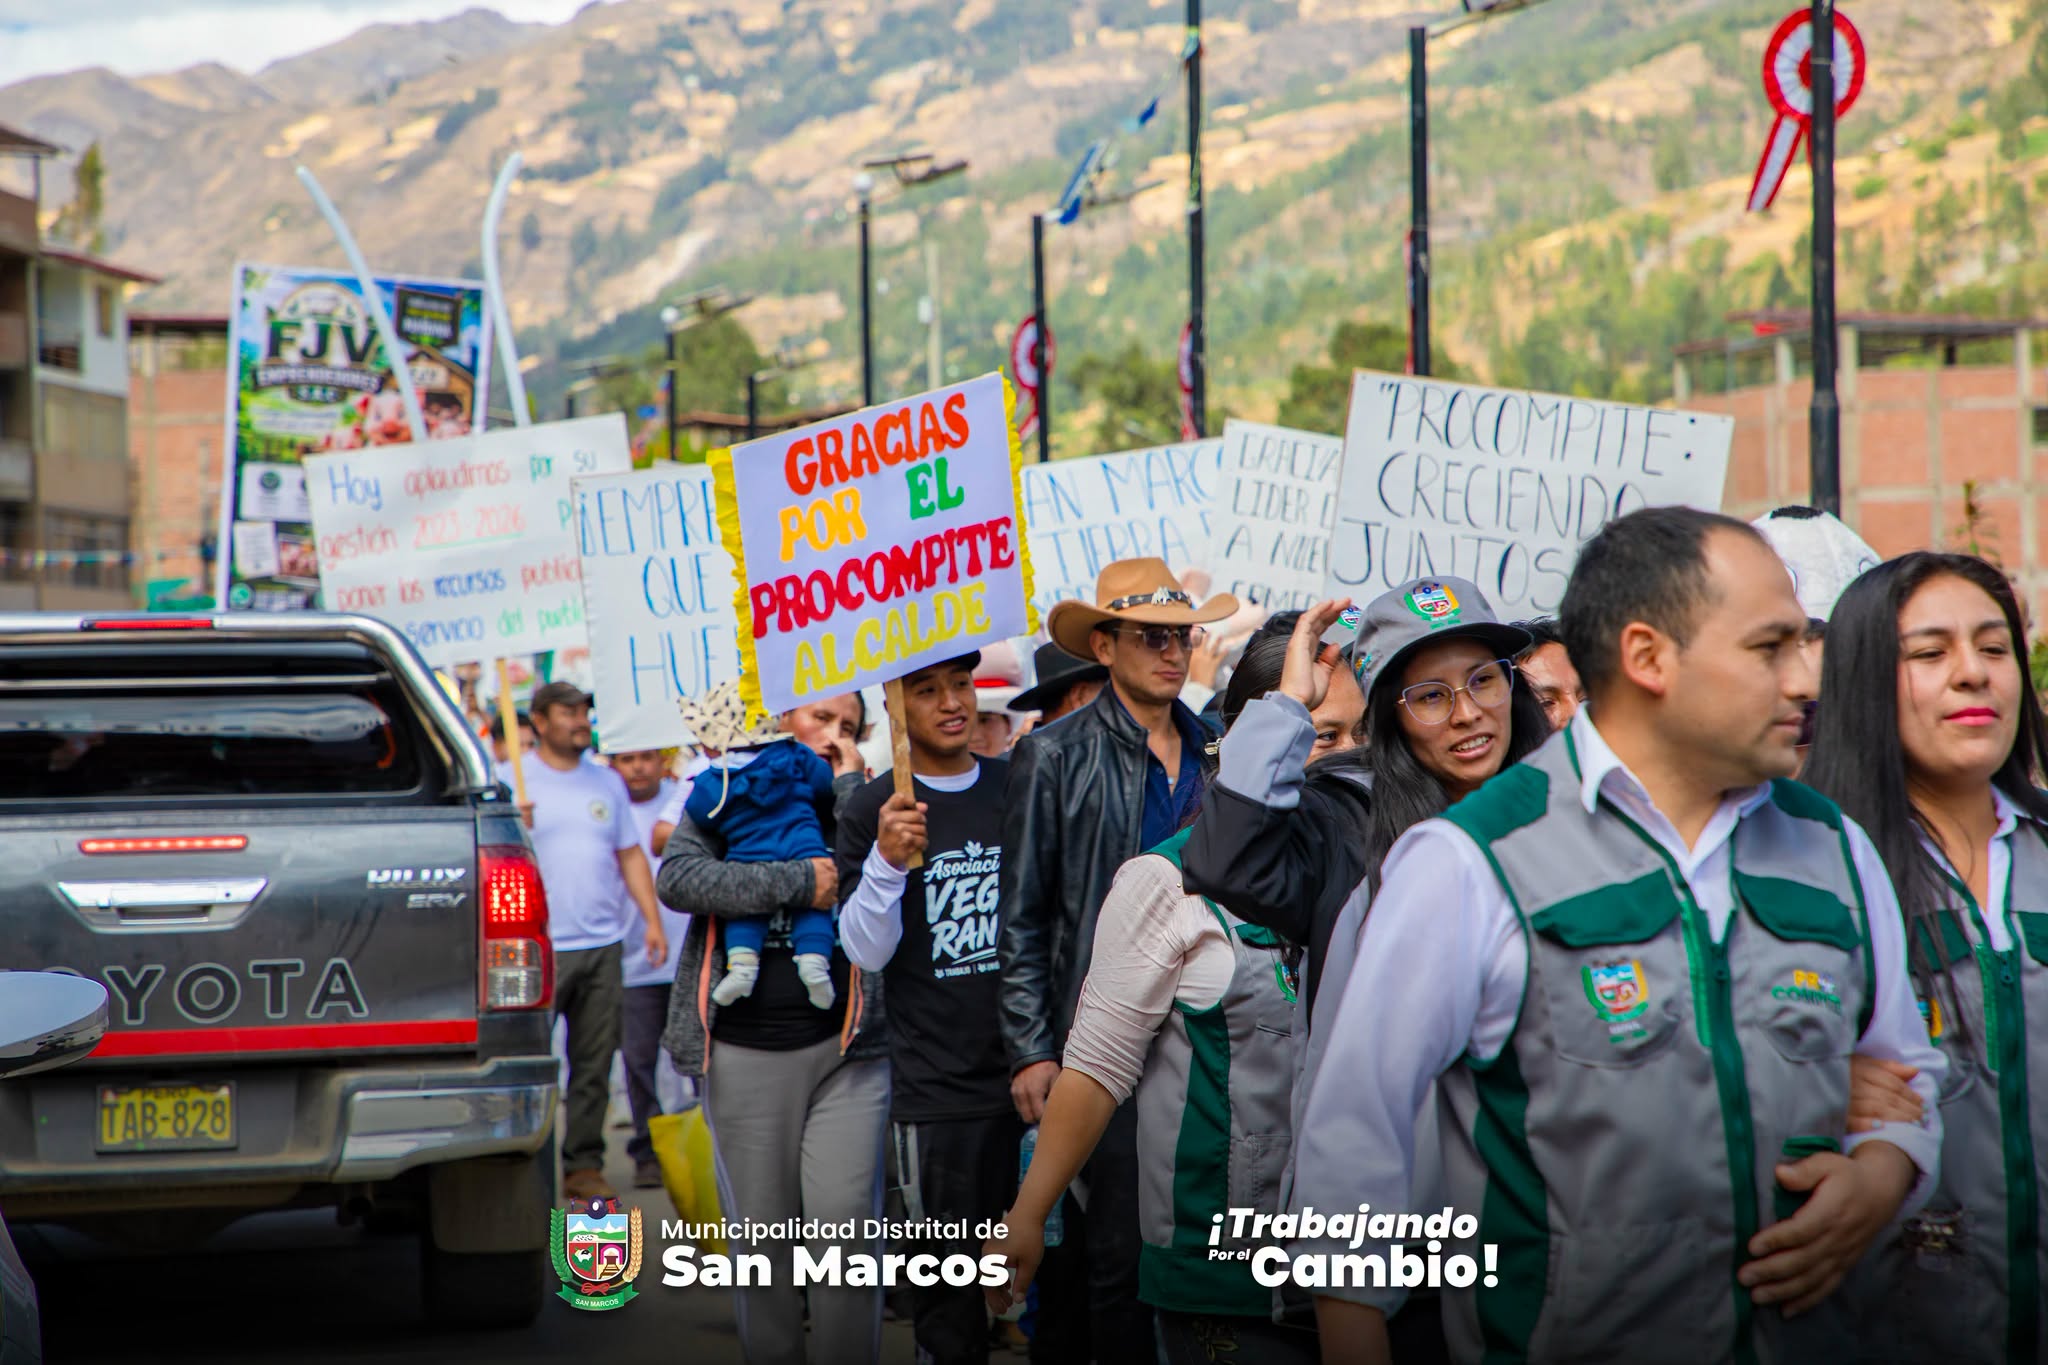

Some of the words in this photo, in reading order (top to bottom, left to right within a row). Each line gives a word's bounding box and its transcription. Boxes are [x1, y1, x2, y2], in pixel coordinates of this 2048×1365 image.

[266, 319, 380, 364] FJV
[784, 393, 970, 495] GRACIAS
[1239, 432, 1340, 481] GRACIA
[329, 464, 383, 511] Hoy
[529, 453, 554, 483] por
[779, 487, 867, 562] POR
[906, 457, 964, 520] EL
[1023, 466, 1083, 528] AN
[1101, 444, 1223, 515] MARC
[751, 517, 1015, 638] PROCOMPITE
[1225, 524, 1252, 559] A
[1270, 531, 1329, 573] NUE
[1333, 517, 1573, 612] JUNTOS
[434, 568, 506, 600] recursos
[643, 551, 718, 619] QUE
[630, 624, 740, 705] HUE
[793, 582, 991, 696] ALCALDE
[923, 854, 1000, 883] Asociaci
[925, 873, 1000, 925] VEG
[930, 914, 999, 961] RAN
[36, 957, 370, 1025] YOTA
[101, 1099, 227, 1140] TAB-828
